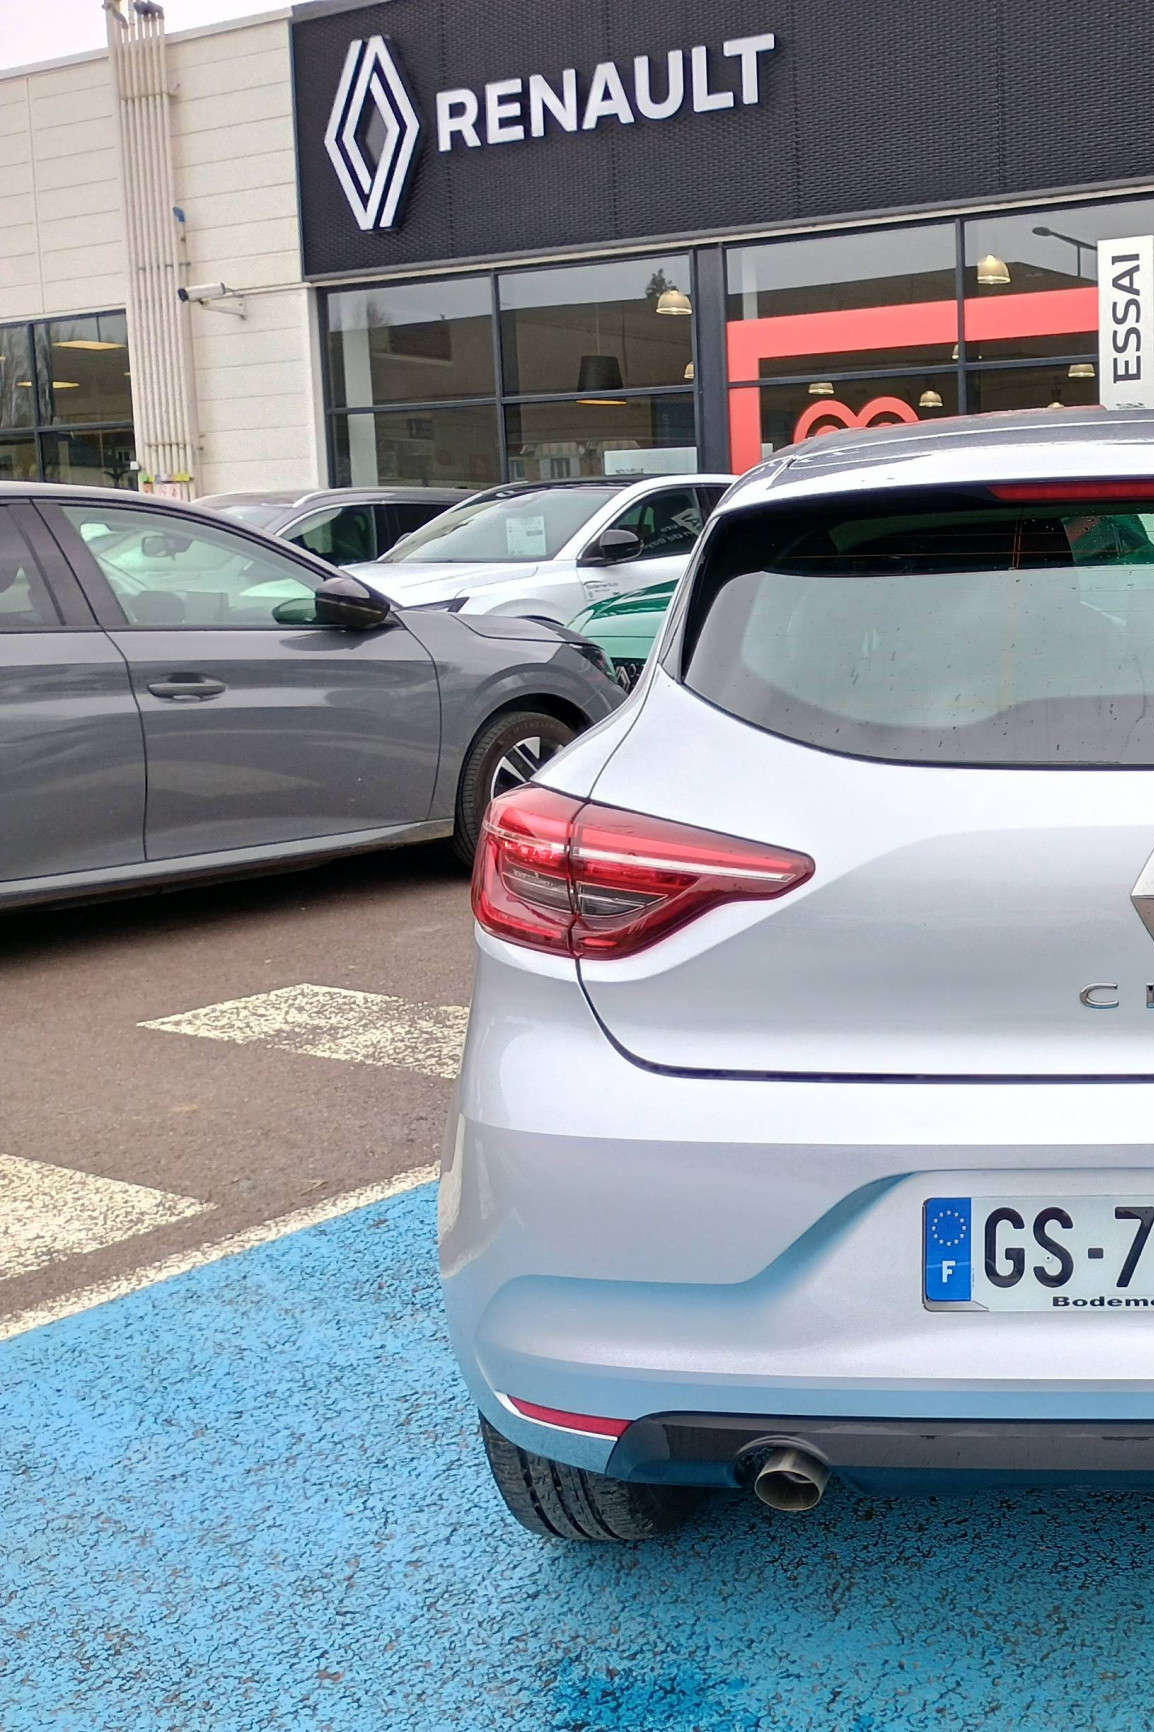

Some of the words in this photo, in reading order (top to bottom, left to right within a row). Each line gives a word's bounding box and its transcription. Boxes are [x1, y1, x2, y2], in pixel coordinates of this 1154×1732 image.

[435, 32, 775, 152] RENAULT
[1111, 252, 1142, 384] ESSAI
[940, 1260, 955, 1283] F
